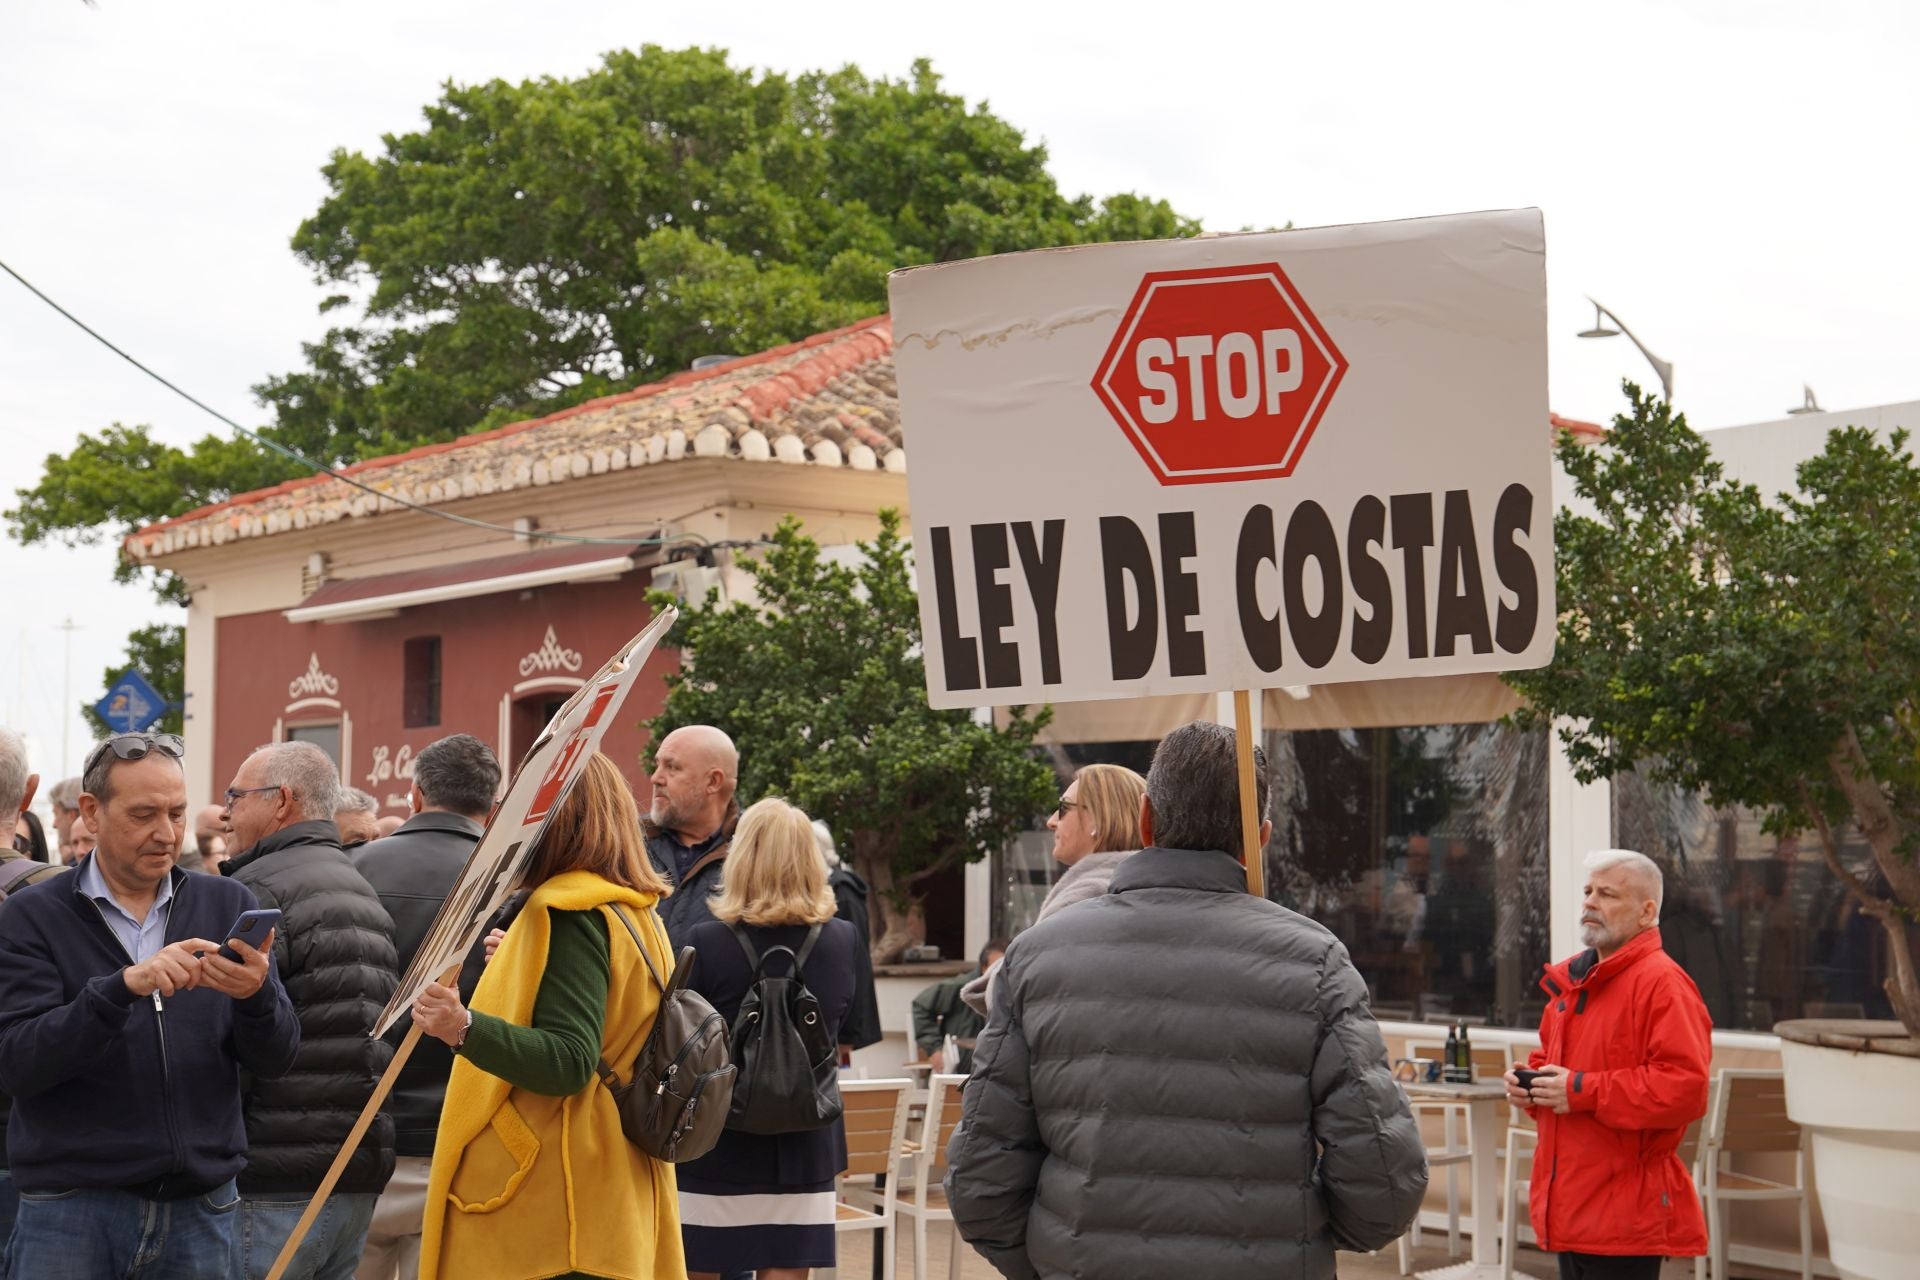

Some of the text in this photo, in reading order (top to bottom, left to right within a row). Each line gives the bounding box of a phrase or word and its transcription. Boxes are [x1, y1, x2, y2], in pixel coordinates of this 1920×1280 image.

[1136, 328, 1304, 424] STOP
[930, 482, 1539, 692] LEY DE COSTAS
[542, 727, 596, 787] ST
